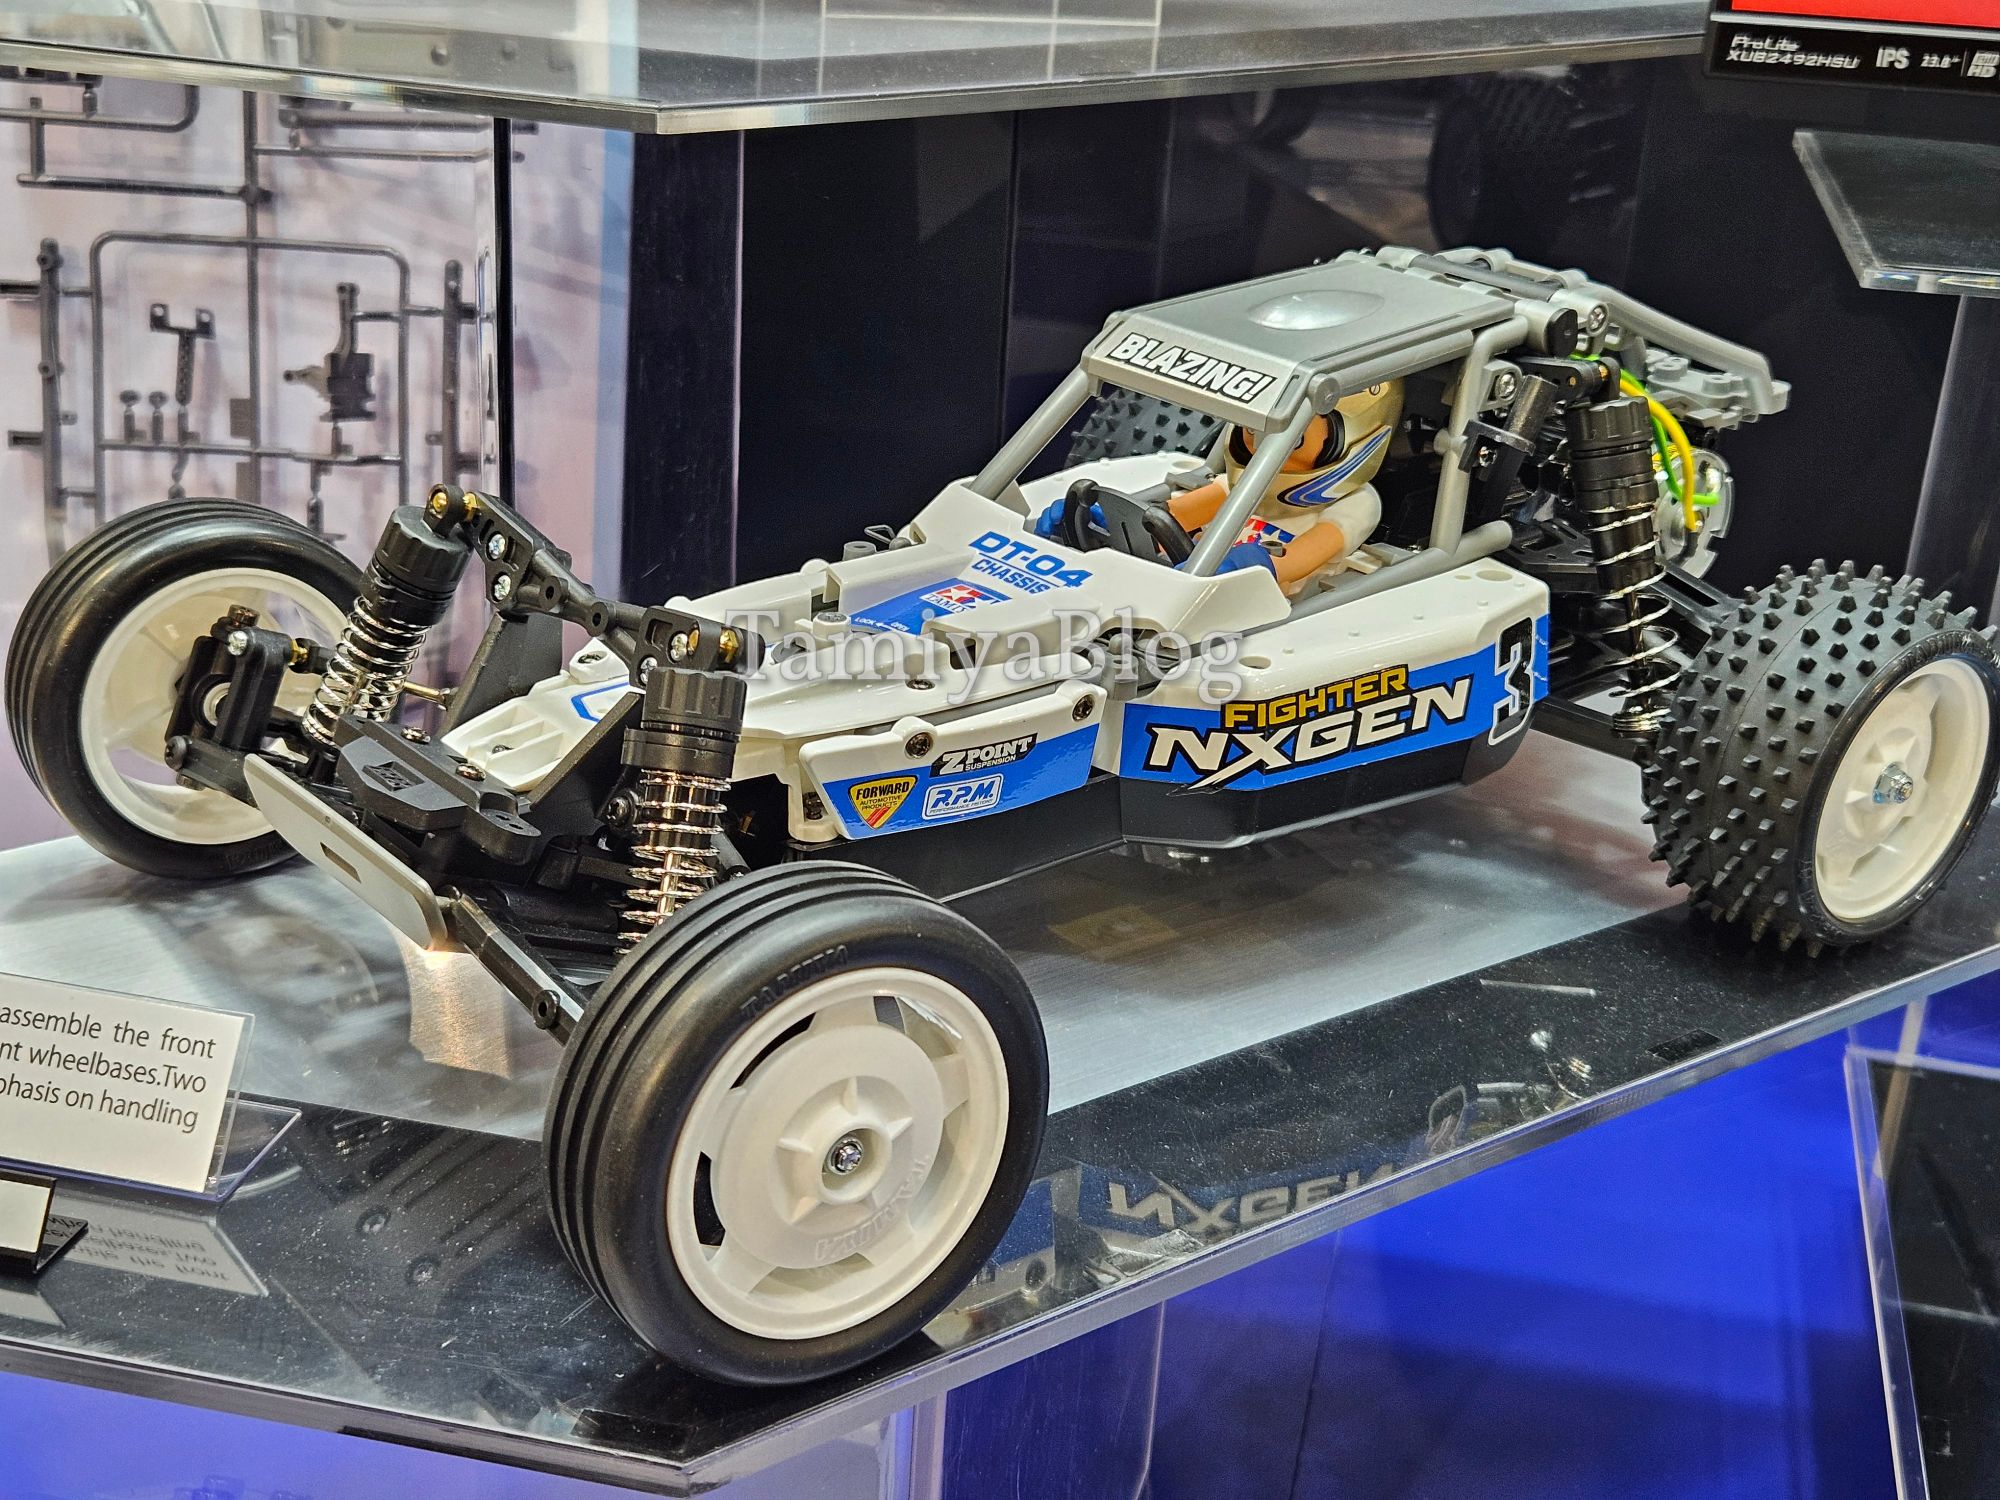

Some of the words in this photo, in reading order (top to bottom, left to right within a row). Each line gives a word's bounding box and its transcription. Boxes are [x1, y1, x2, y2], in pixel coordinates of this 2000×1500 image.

[1731, 36, 1800, 51] ProLite
[1876, 46, 1910, 69] IPS
[1726, 50, 1860, 69] XUB2492HSU
[1966, 65, 1997, 77] HD
[1109, 332, 1276, 403] BLAZING!
[968, 531, 1093, 588] DT-04
[971, 558, 1051, 594] CHASSIS
[1488, 615, 1536, 745] 3
[1223, 667, 1409, 729] FIGHTER
[1149, 678, 1471, 790] NXGEN
[965, 755, 1016, 771] SUSPENSION
[856, 782, 910, 800] FORWARD
[859, 795, 902, 806] AUTOMOTIVE
[931, 780, 996, 809] R.P.M.
[861, 801, 898, 811] PRODUCTS
[0, 1007, 102, 1039] assemble
[114, 1021, 150, 1047] the
[160, 1028, 217, 1059] front
[65, 1090, 94, 1110] on
[99, 1089, 199, 1133] handling
